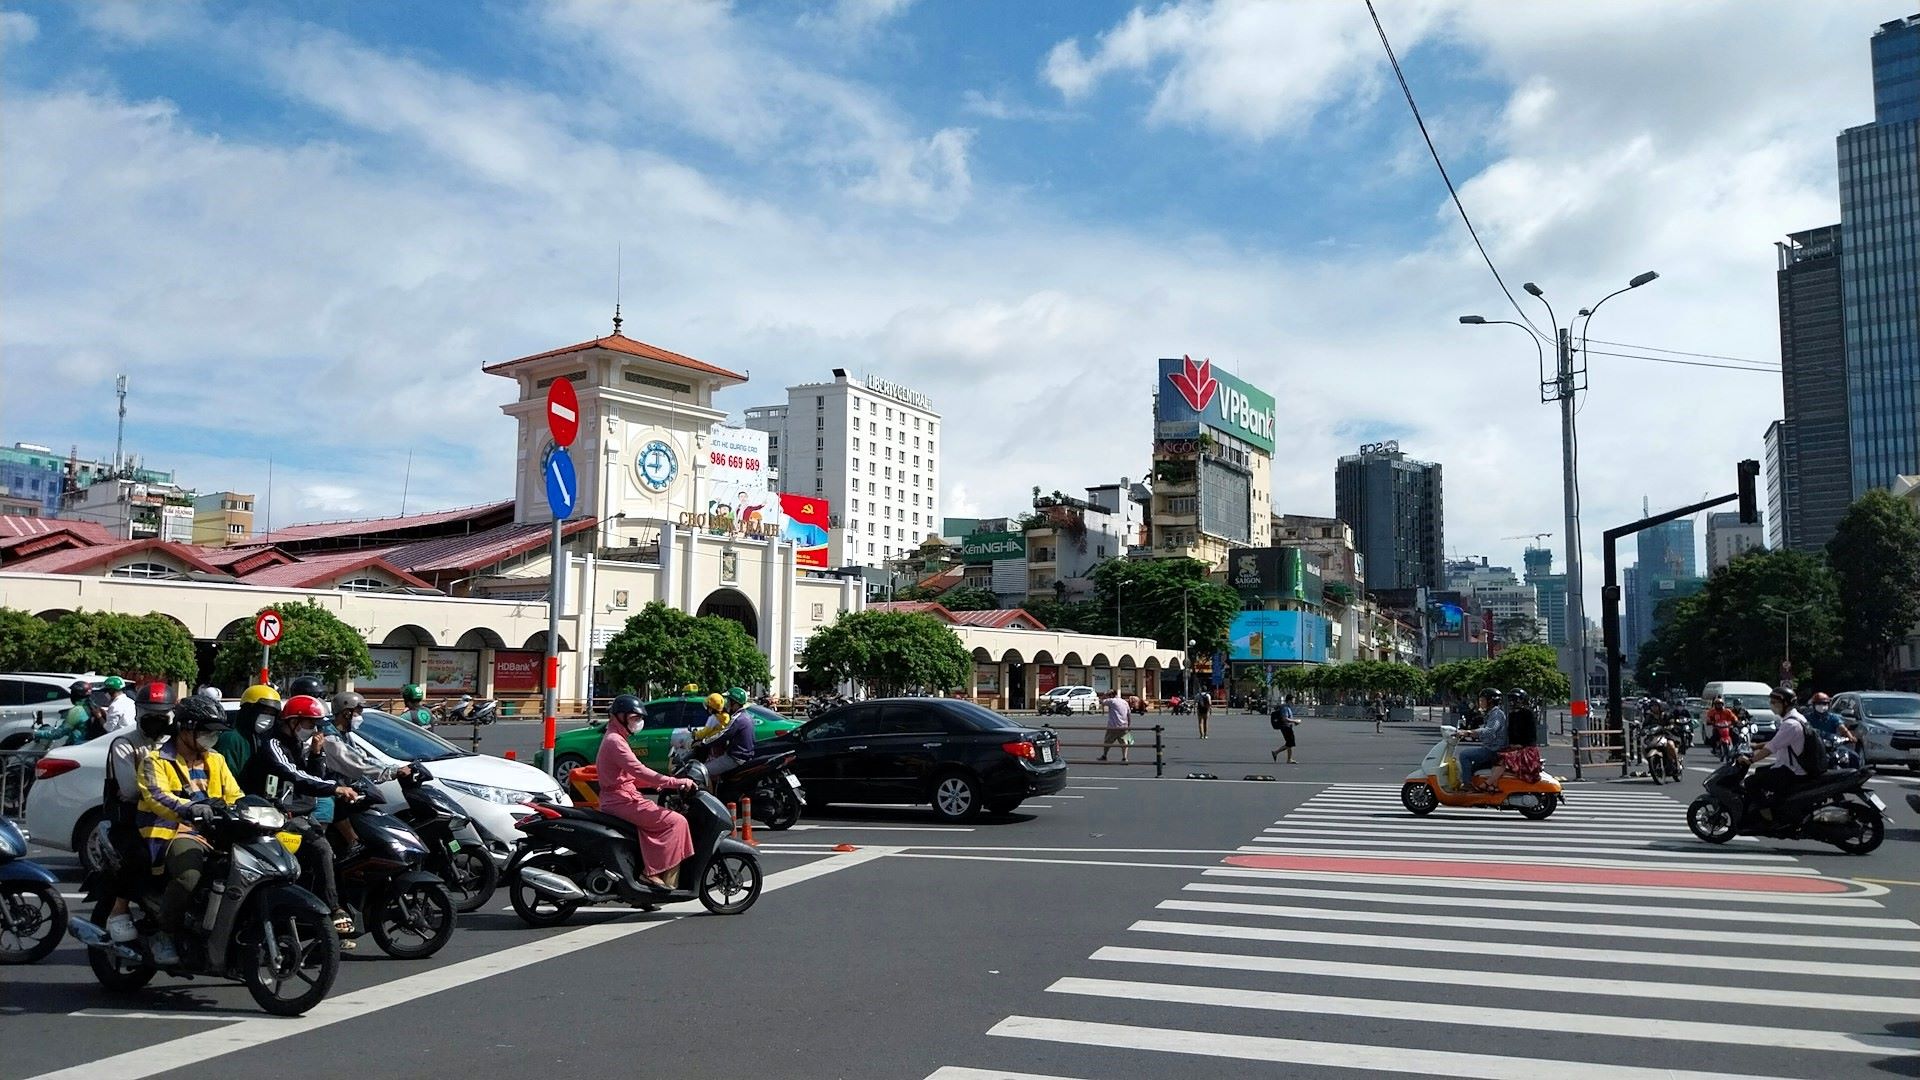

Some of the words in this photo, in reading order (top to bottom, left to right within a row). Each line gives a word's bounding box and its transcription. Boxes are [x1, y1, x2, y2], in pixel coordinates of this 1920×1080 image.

[1793, 243, 1830, 257] Keppel
[868, 373, 897, 398] LIBERTY
[897, 385, 928, 408] CENTRAL
[1218, 382, 1274, 441] VPBank
[711, 451, 726, 467] 986
[728, 455, 743, 469] 669
[745, 457, 760, 472] 689
[497, 661, 530, 672] HDBank
